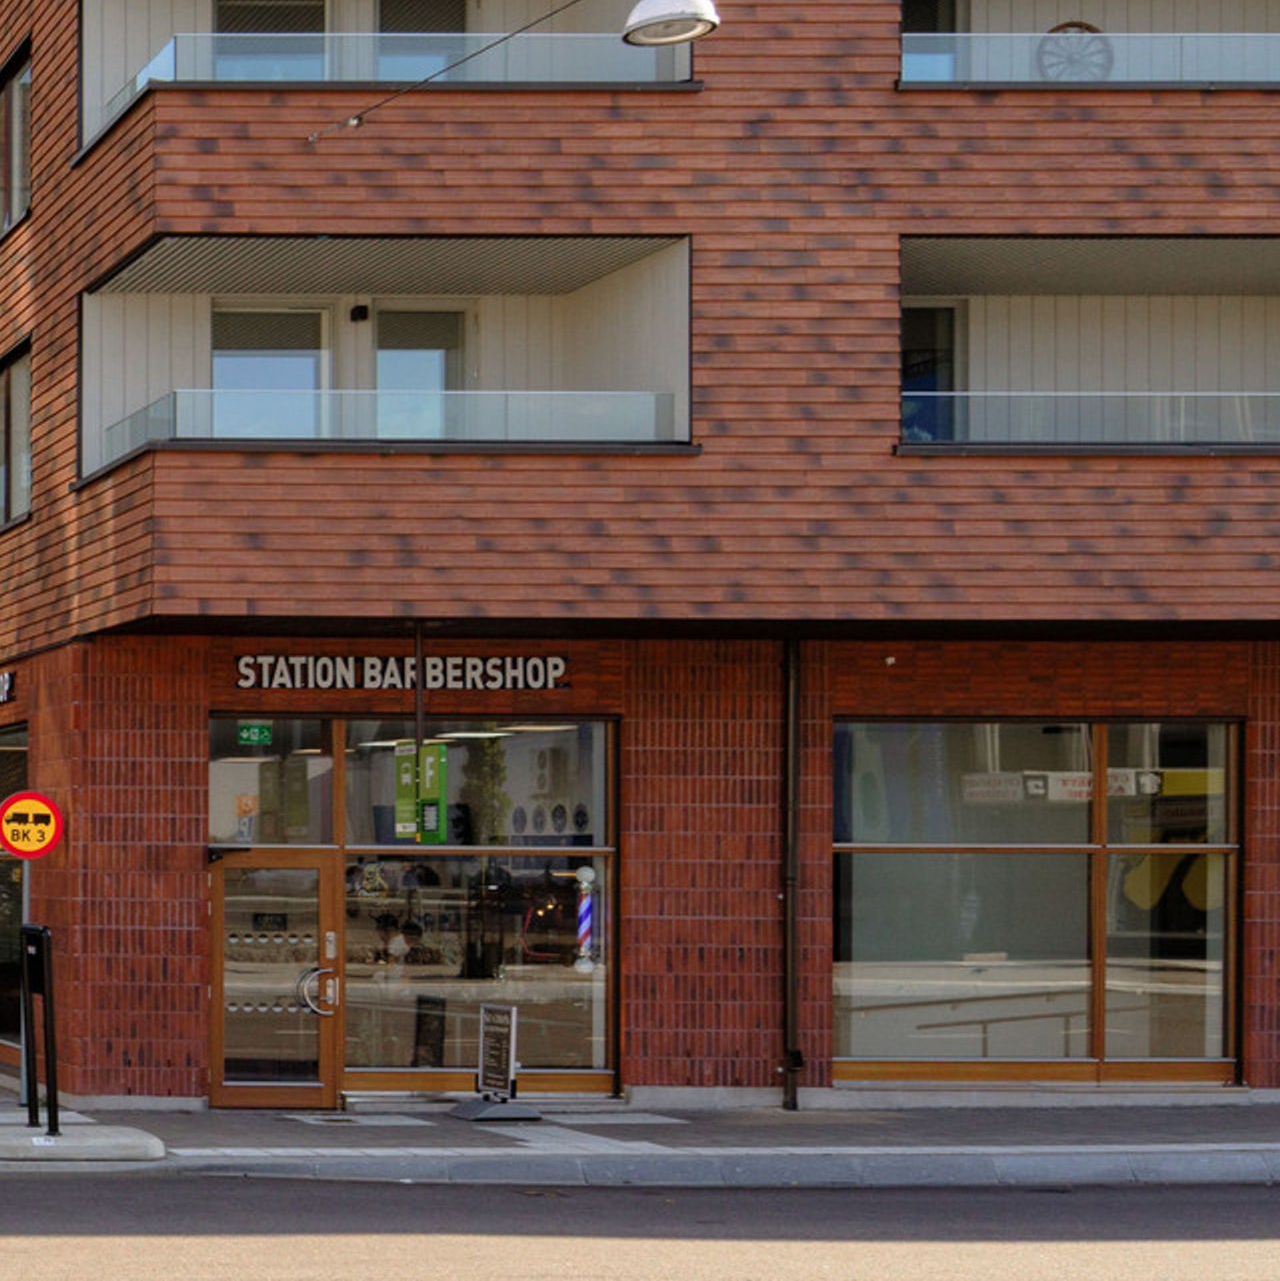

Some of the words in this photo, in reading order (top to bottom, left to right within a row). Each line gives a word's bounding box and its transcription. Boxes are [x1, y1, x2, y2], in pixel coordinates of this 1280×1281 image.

[238, 656, 354, 688] STATION
[364, 657, 566, 689] BARBERSHOP
[10, 829, 31, 843] BK
[36, 829, 46, 843] 3
